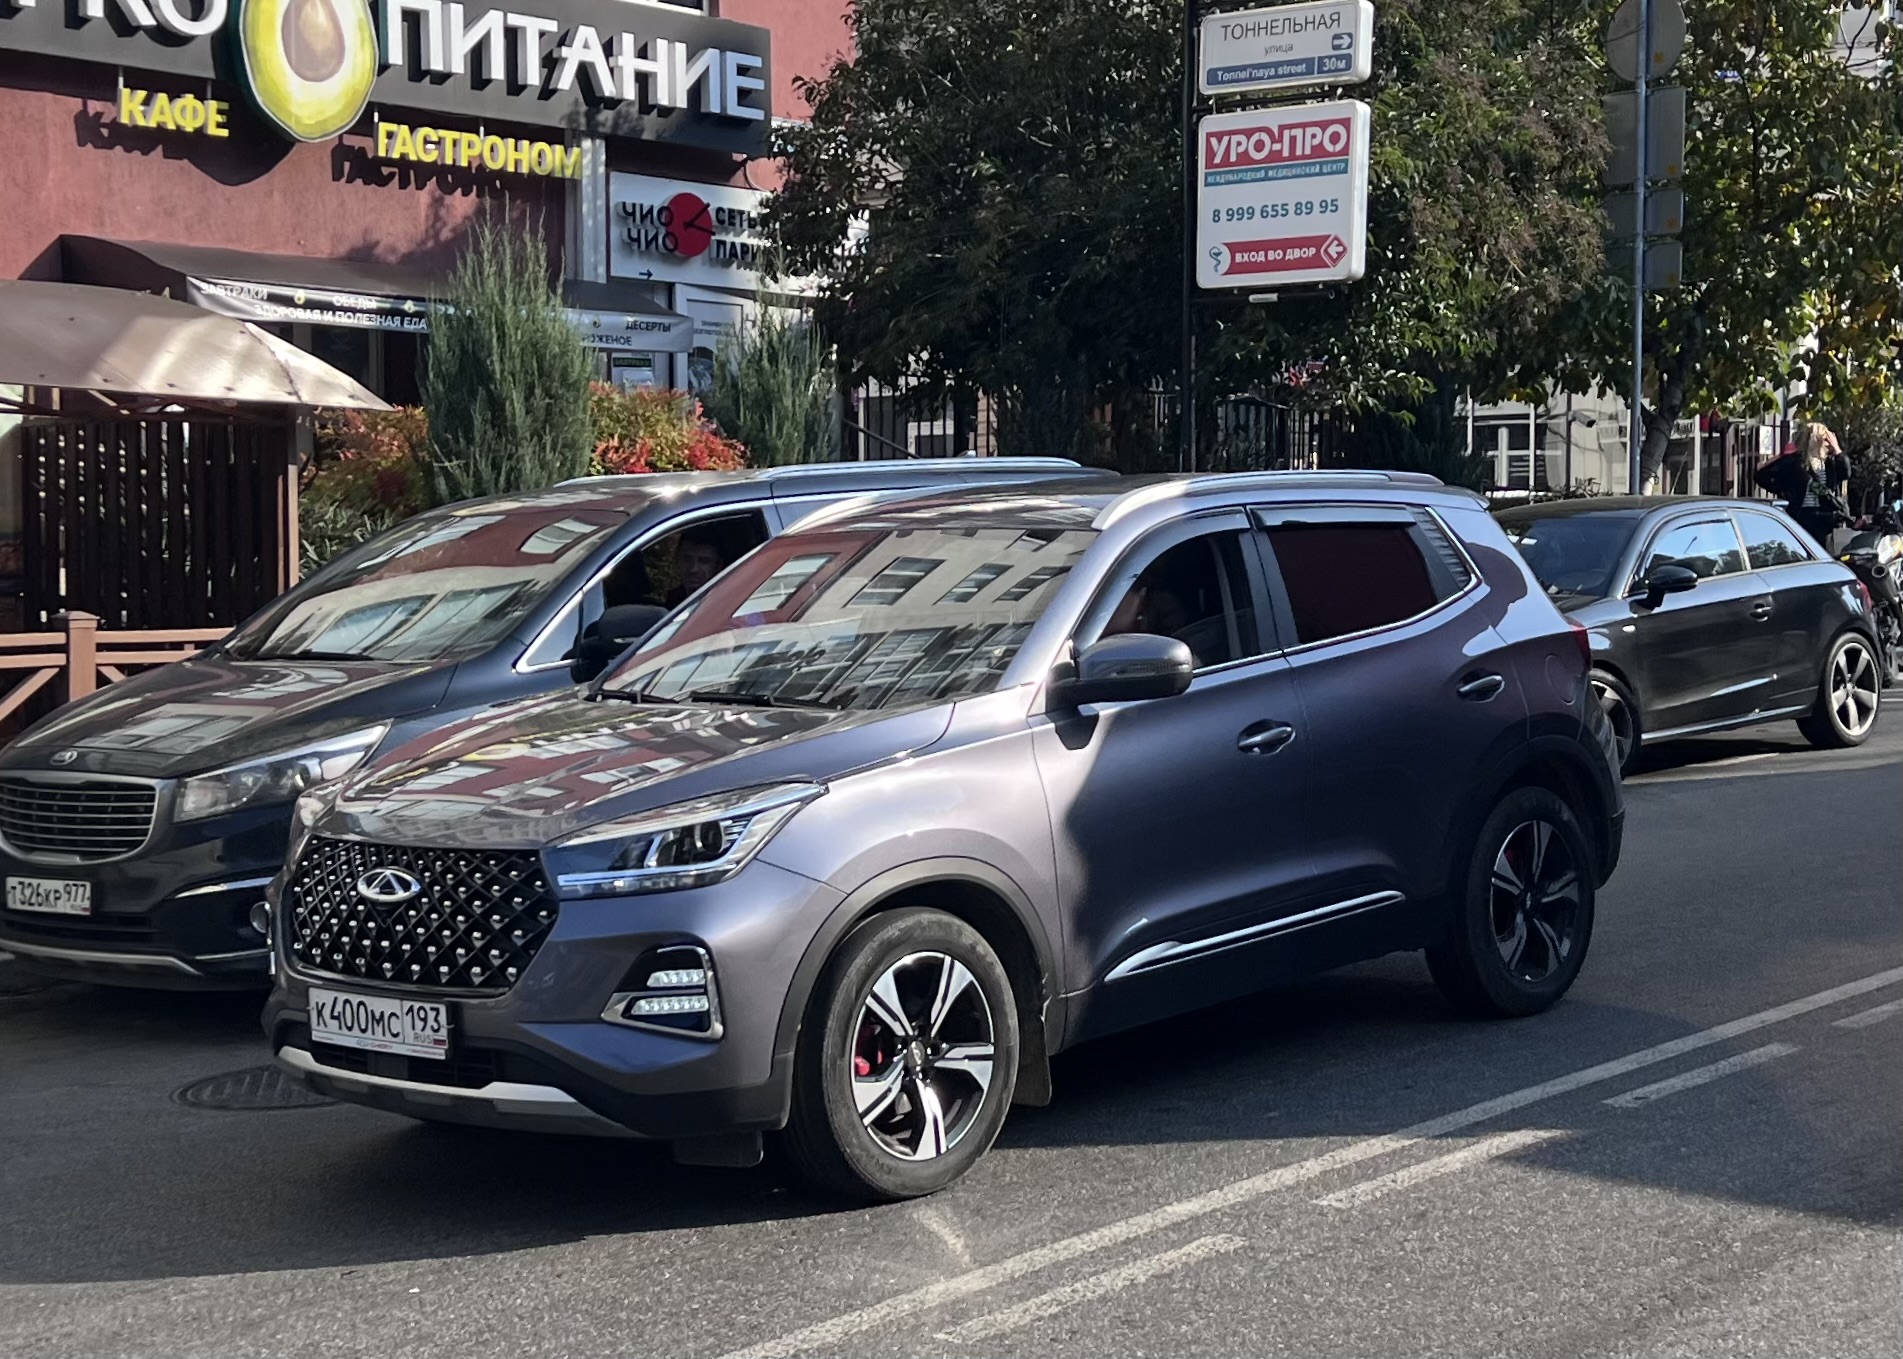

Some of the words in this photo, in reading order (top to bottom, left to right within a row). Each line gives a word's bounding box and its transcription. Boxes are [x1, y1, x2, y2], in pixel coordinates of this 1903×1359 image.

[1221, 11, 1341, 41] ТОННЕЛЬНАЯ
[387, 0, 765, 121] ПИТАНИЕ
[1263, 43, 1294, 56] улица
[1277, 63, 1306, 75] street
[119, 87, 230, 137] КАФЕ
[377, 121, 582, 180] ГАСТРОНОМ
[1209, 123, 1348, 164] УРО-ПРО
[1322, 161, 1346, 174] ЦЕНТР
[622, 201, 674, 227] ЧИО
[715, 206, 758, 229] СЕТЬ
[1212, 208, 1221, 223] 8
[1225, 206, 1255, 222] 999
[1260, 203, 1289, 219] 655
[1294, 200, 1314, 216] 89
[1319, 198, 1339, 214] 95
[627, 227, 679, 251] ЧИО
[1235, 251, 1266, 263] ВХОД
[1267, 249, 1283, 261] ВО
[1285, 247, 1316, 261] ДВОР
[200, 282, 268, 300] ЗАВТРАКИ
[332, 294, 377, 309] ОБЕДЫ
[253, 303, 321, 321] ЗДОРОВАЯ
[322, 310, 333, 322] И
[334, 311, 402, 328] ПОЛЕЗНАЯ
[403, 316, 428, 330] ЕДА
[625, 320, 671, 333] ДЕСЕРТЫ
[10, 881, 62, 908] Т326КР
[63, 883, 87, 903] 977
[315, 996, 400, 1039] К400МС
[405, 1004, 442, 1034] 193
[413, 1033, 433, 1045] RUS
